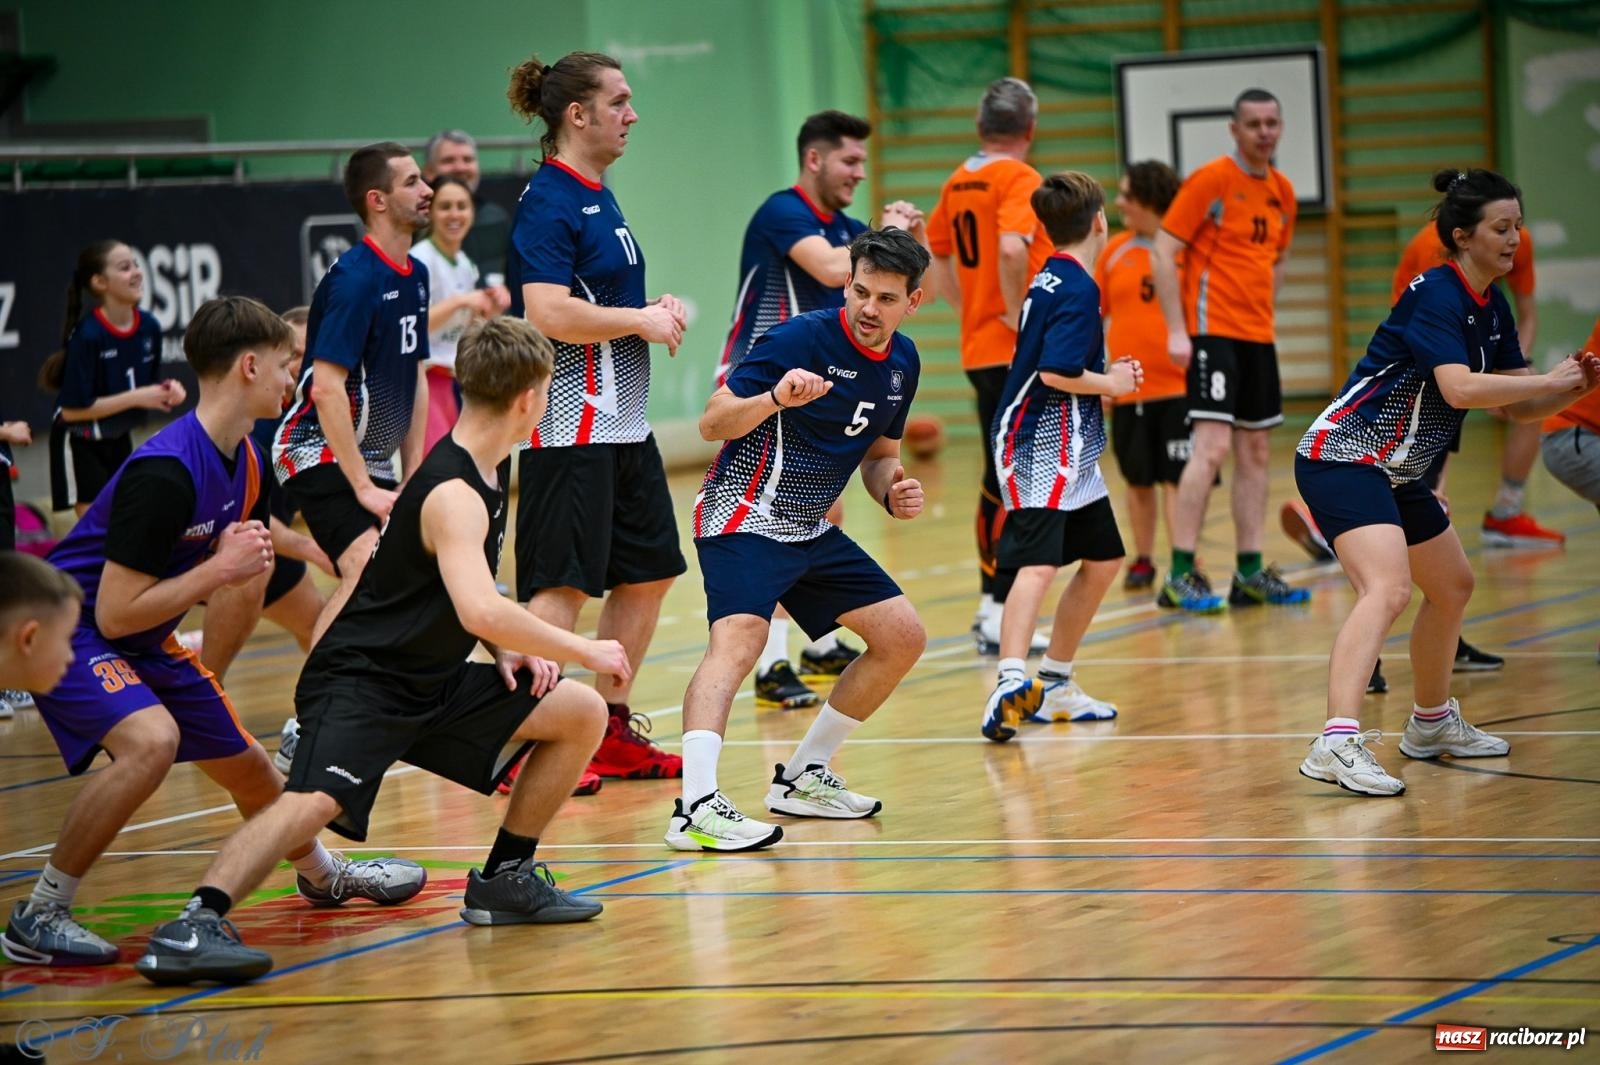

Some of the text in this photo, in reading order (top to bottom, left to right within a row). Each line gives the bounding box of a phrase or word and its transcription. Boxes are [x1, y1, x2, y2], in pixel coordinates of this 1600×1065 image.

[1251, 216, 1267, 244] 11
[399, 315, 417, 355] 13
[1210, 371, 1226, 401] 8
[844, 401, 876, 437] 5
